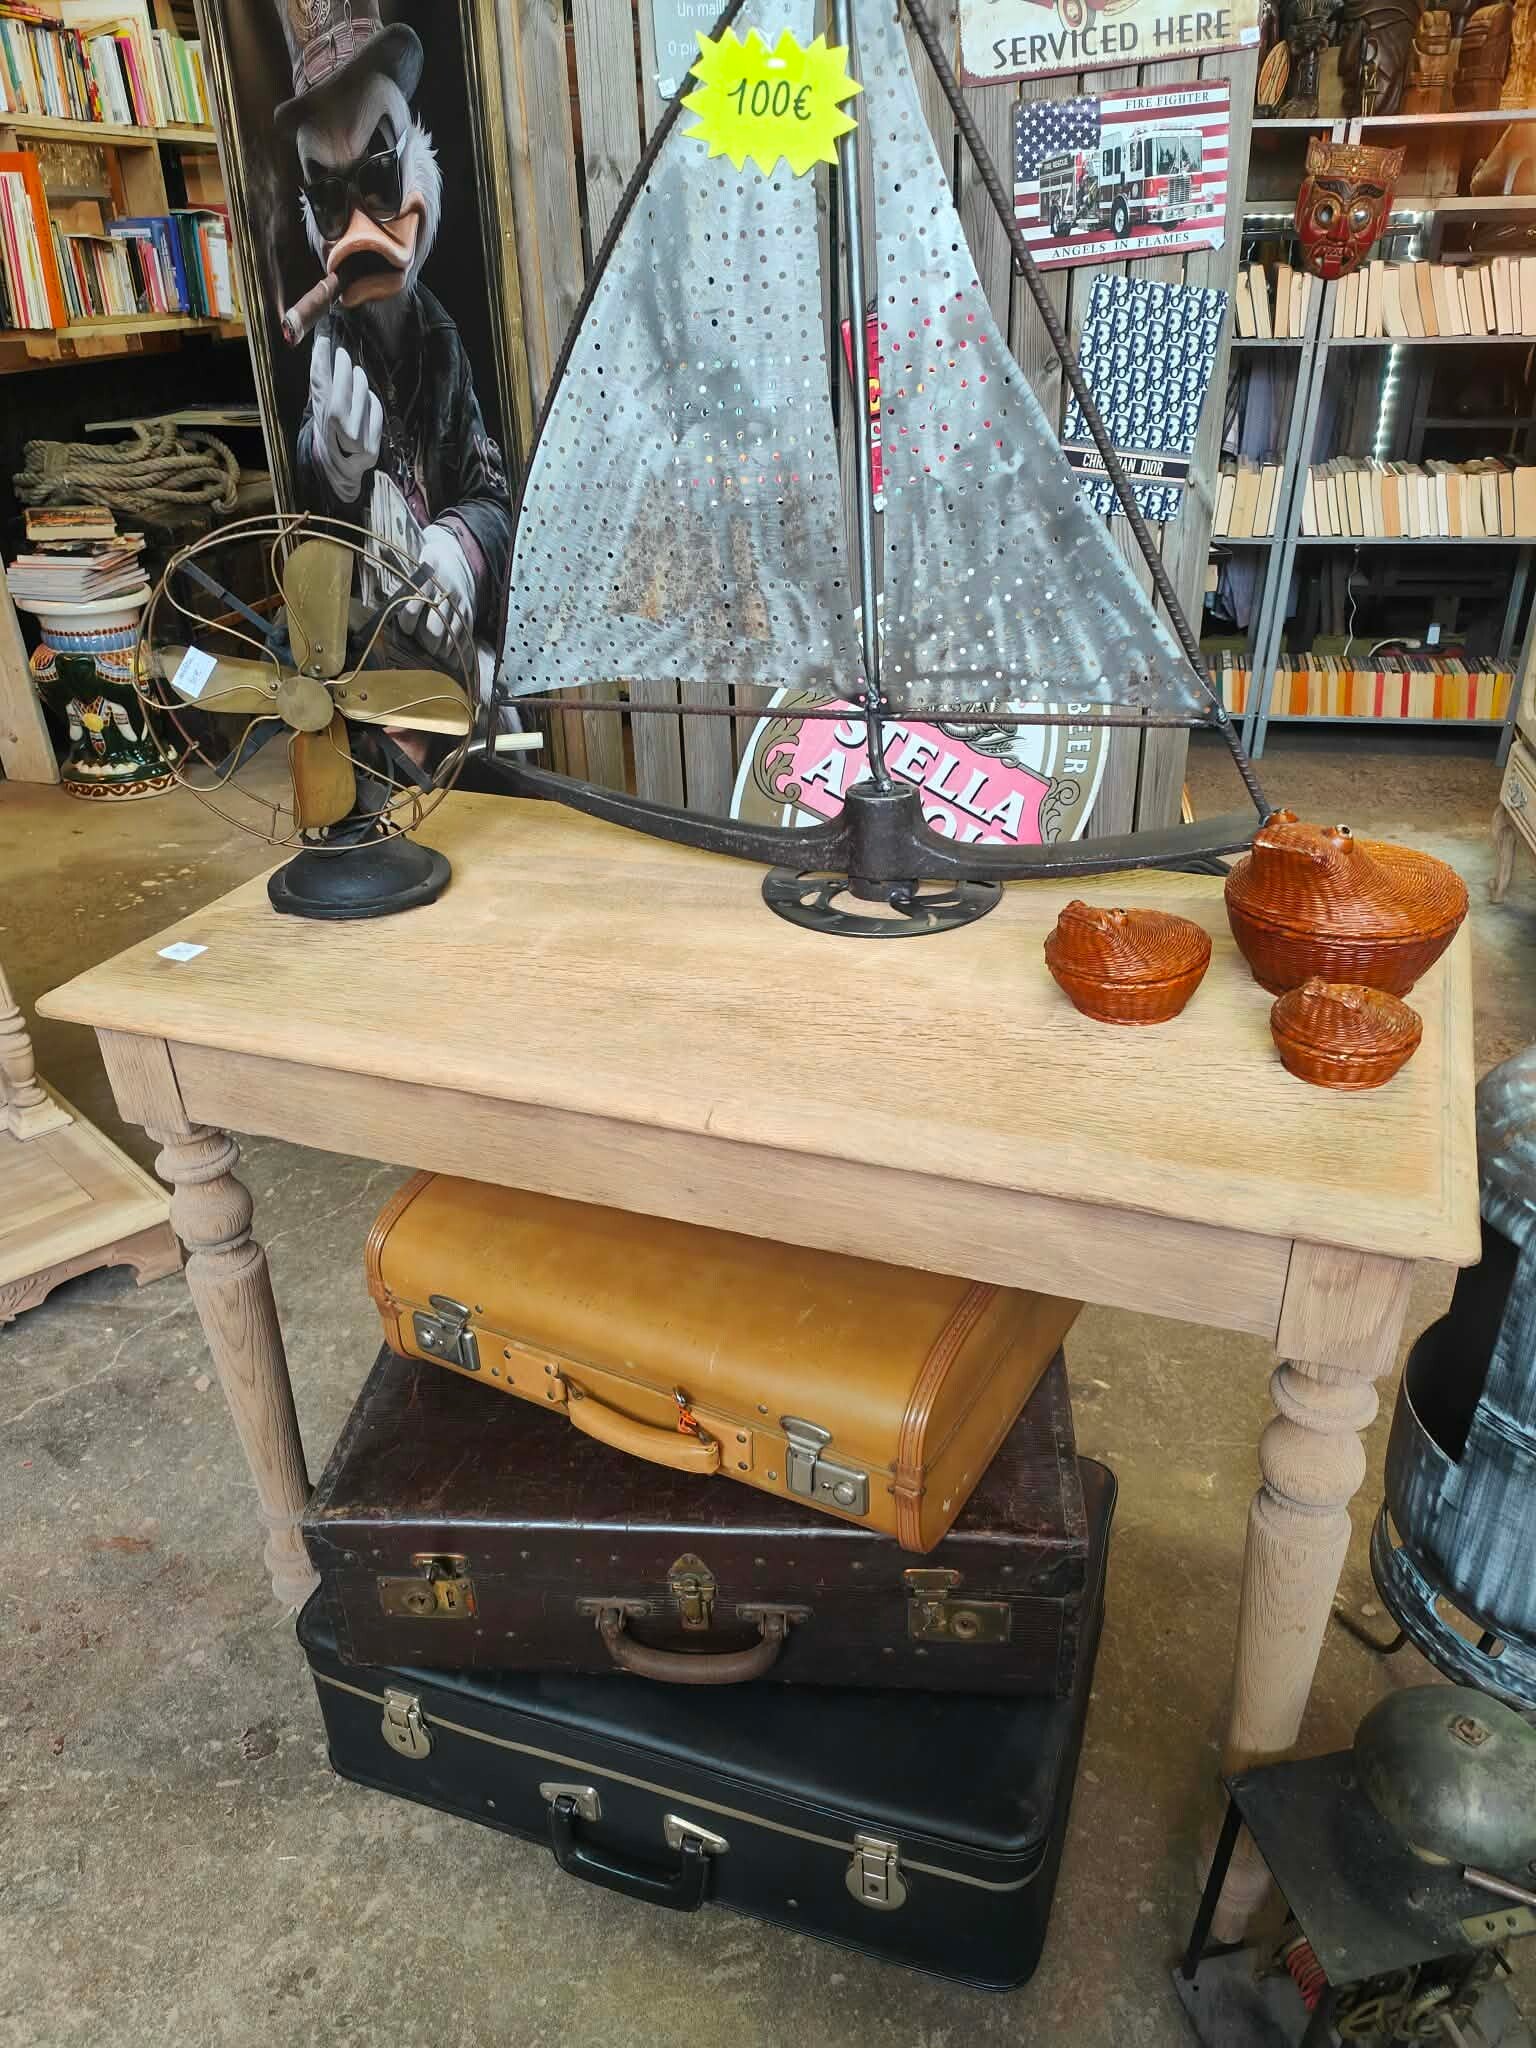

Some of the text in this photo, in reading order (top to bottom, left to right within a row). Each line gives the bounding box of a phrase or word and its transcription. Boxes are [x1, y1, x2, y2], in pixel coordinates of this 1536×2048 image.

[992, 9, 1231, 69] SERVICED HERE
[727, 78, 812, 120] 100€
[1125, 91, 1209, 110] FIRE FIGHTER
[1051, 232, 1190, 259] ANGELS IN FLAMES
[1139, 460, 1164, 476] DIOR
[1063, 703, 1092, 775] BEER
